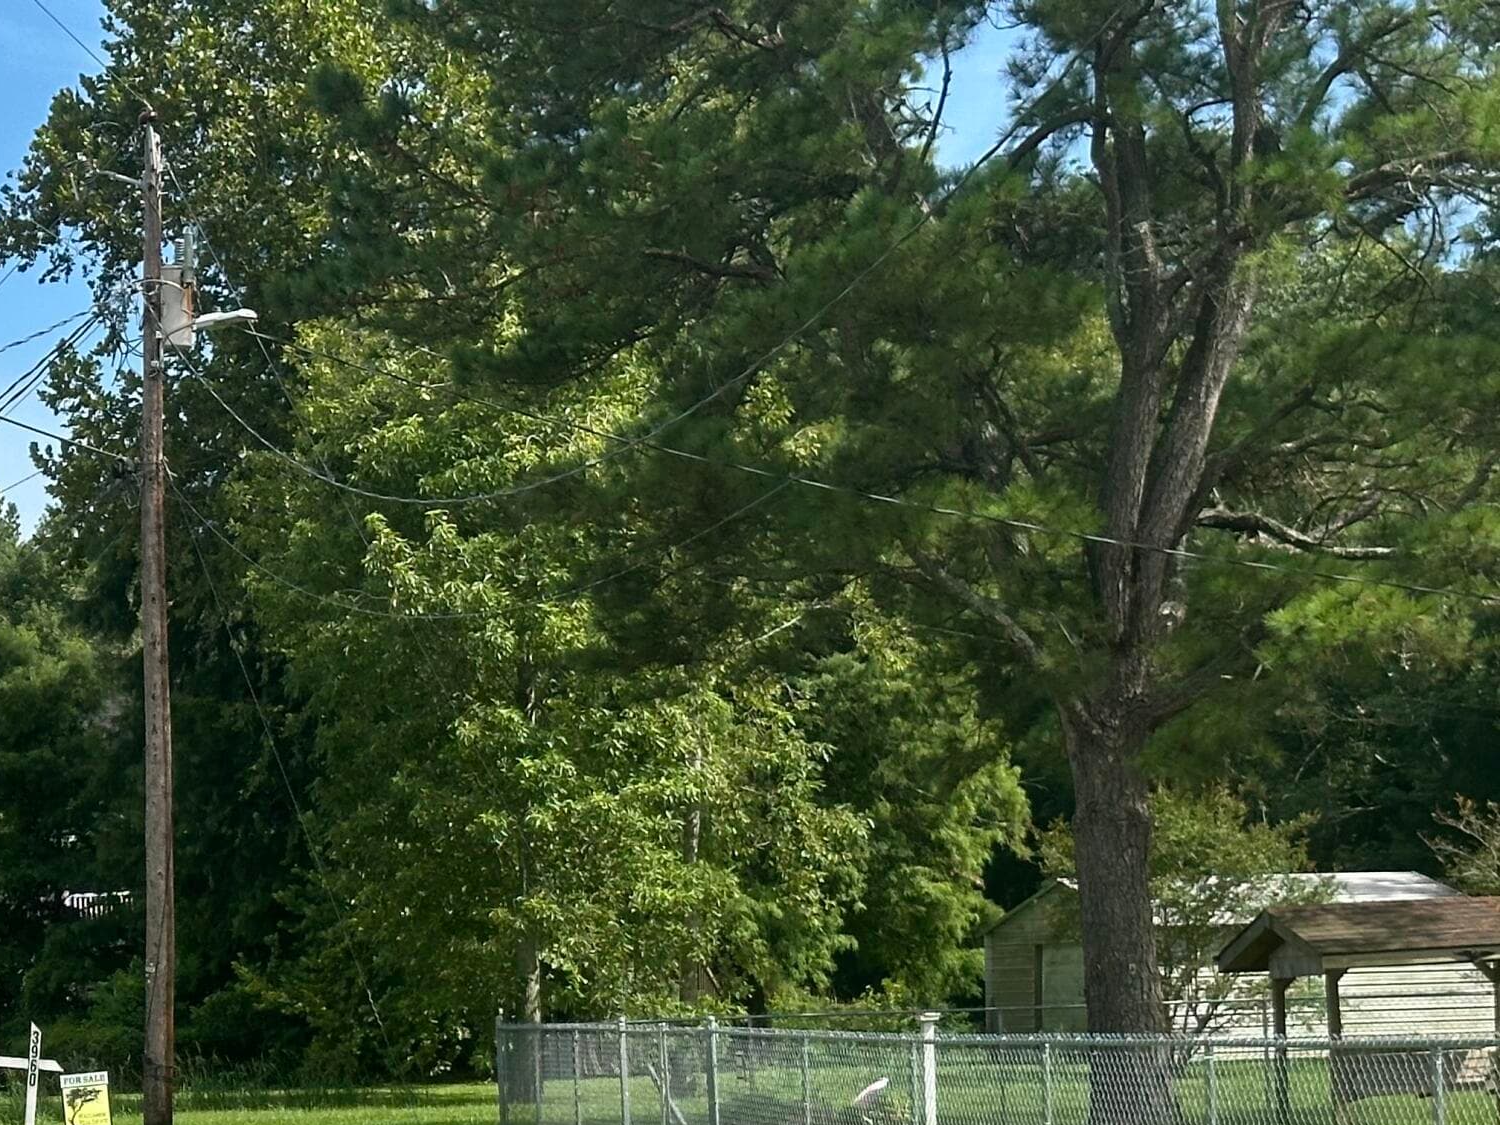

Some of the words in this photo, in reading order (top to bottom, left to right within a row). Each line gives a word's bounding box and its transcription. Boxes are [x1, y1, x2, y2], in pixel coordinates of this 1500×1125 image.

[30, 1031, 39, 1086] 3960
[63, 1076, 81, 1085] FOR
[83, 1074, 105, 1083] SALE
